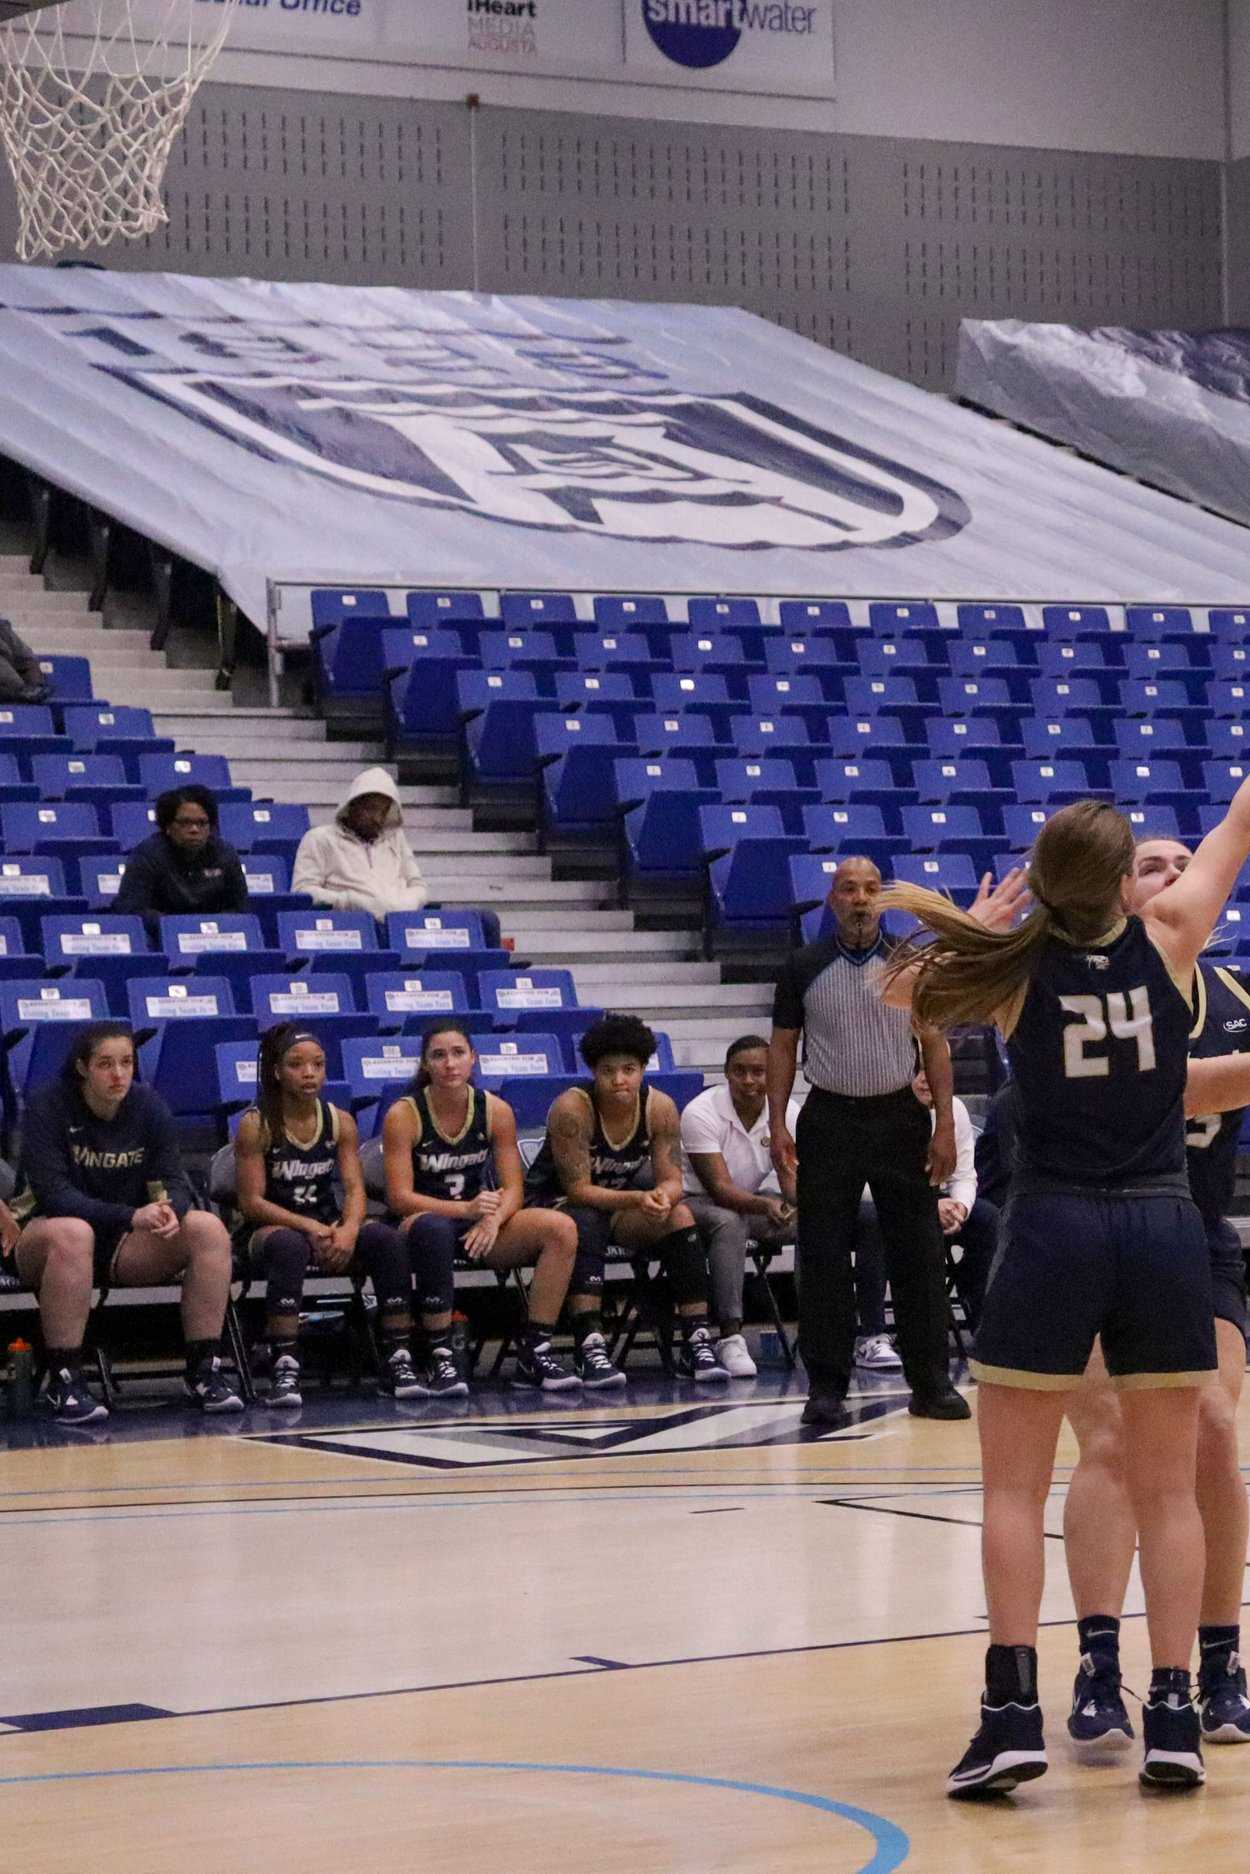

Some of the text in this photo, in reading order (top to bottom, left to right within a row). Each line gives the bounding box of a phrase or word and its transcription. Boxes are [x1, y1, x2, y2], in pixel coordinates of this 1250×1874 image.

[467, 17, 536, 38] MEDIA
[1058, 985, 1156, 1079] 24
[1224, 1018, 1248, 1030] SAC
